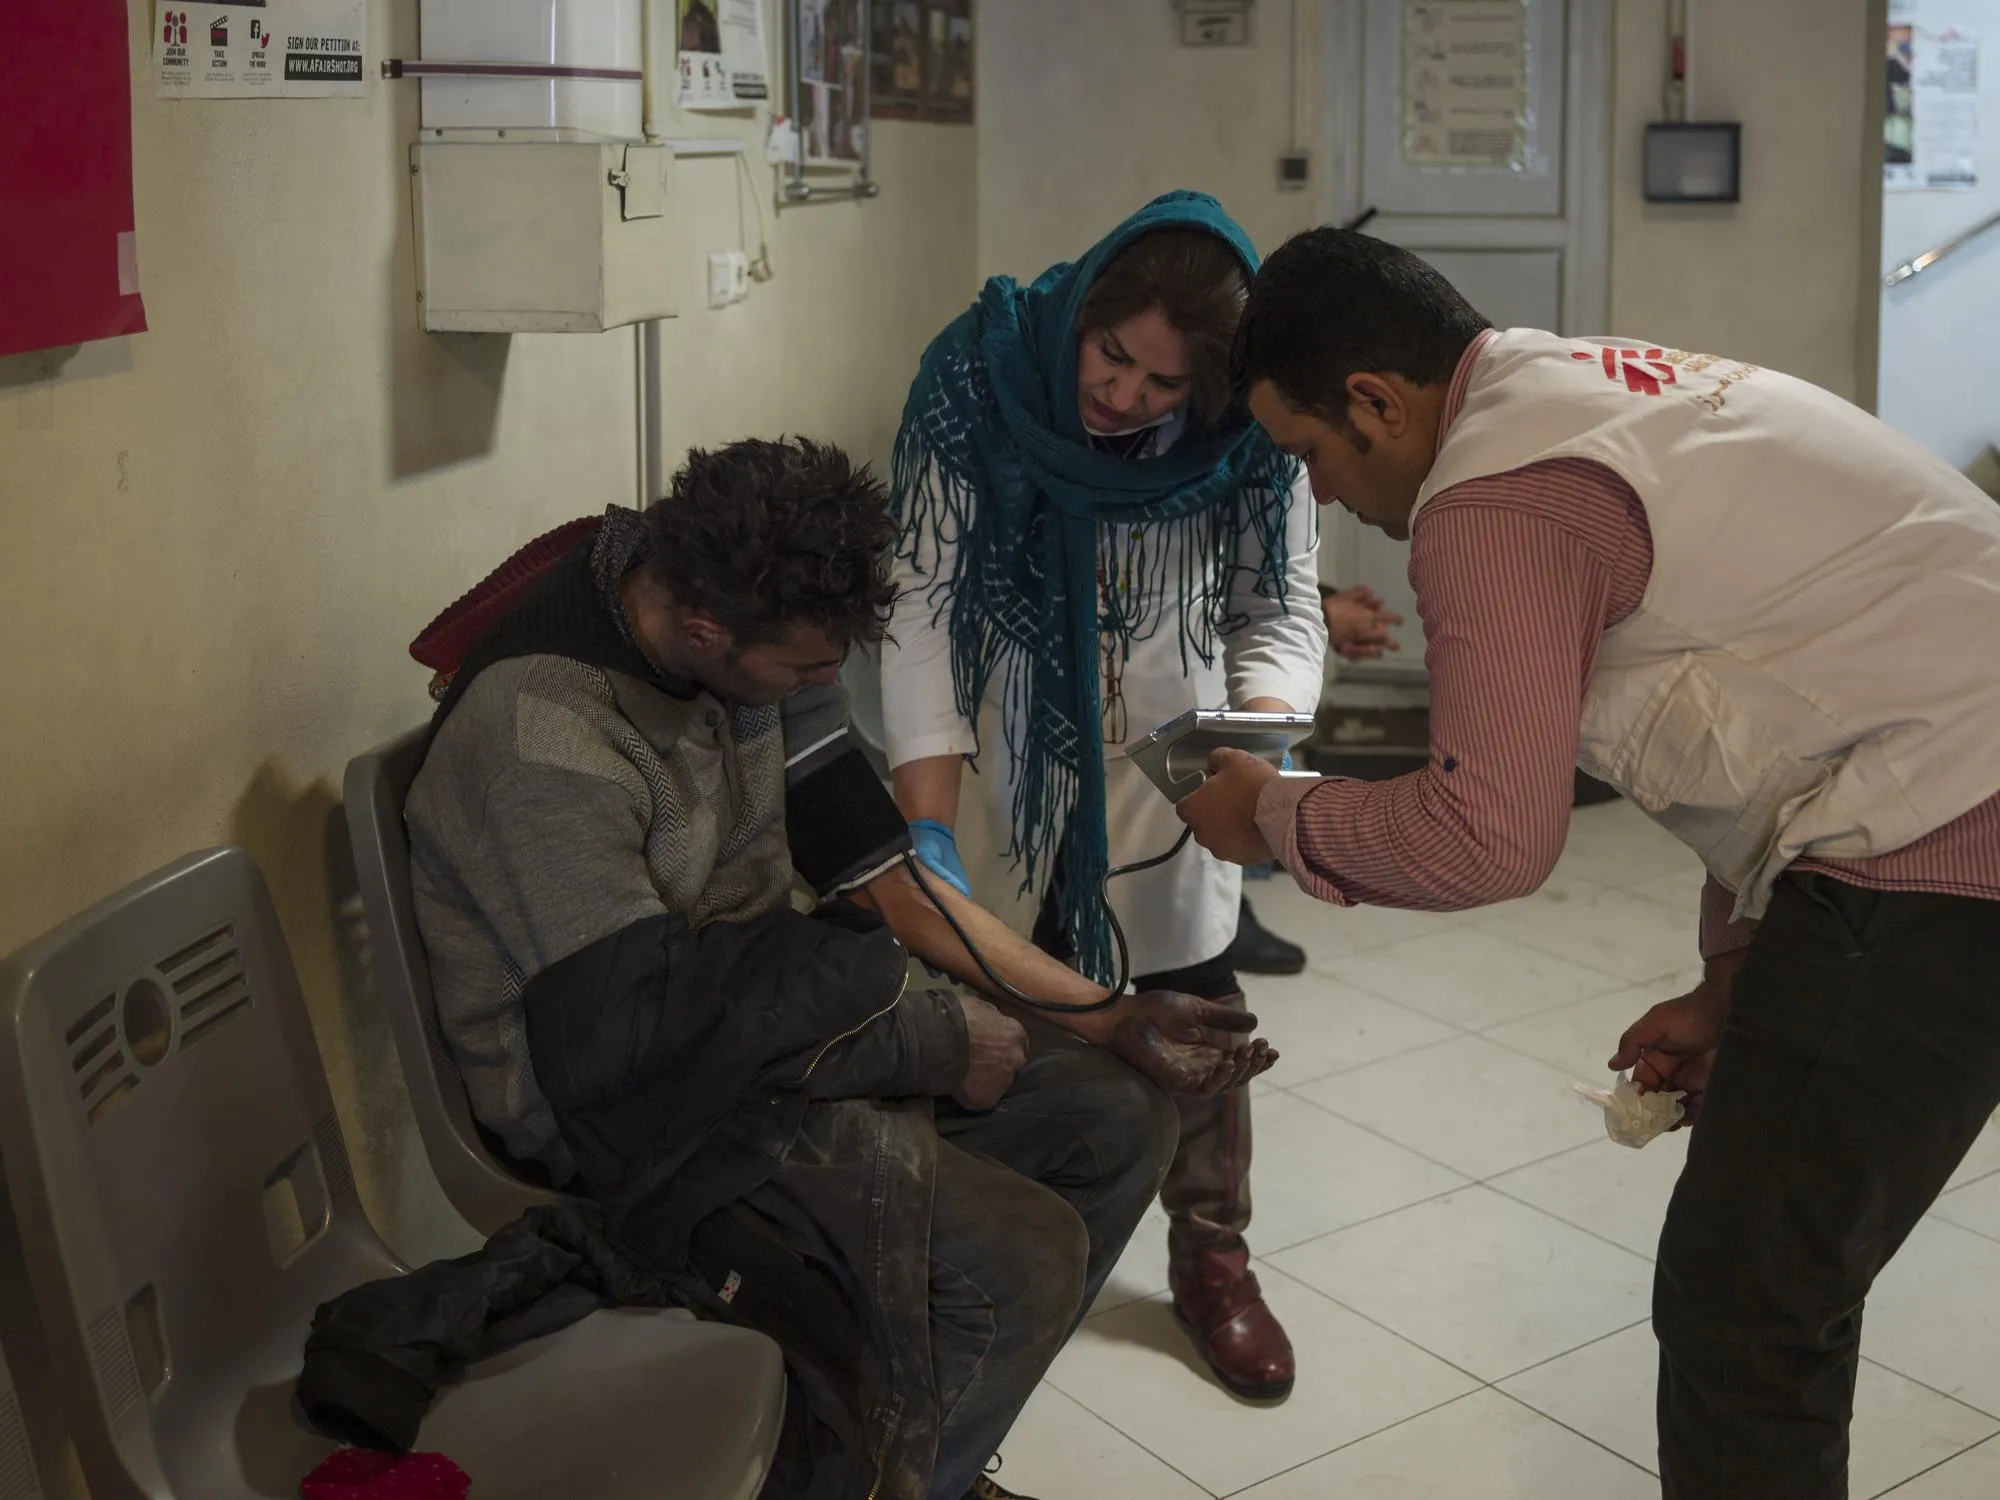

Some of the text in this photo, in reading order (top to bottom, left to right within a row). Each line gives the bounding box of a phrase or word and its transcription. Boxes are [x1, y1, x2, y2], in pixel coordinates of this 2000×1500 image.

[287, 36, 360, 52] SIGN OUR PETITION AT:
[166, 47, 186, 56] JOIN OUR
[214, 50, 224, 58] TAKE
[251, 51, 265, 59] SPREAD
[162, 57, 189, 66] COMMUNITY
[256, 60, 266, 68] WORD
